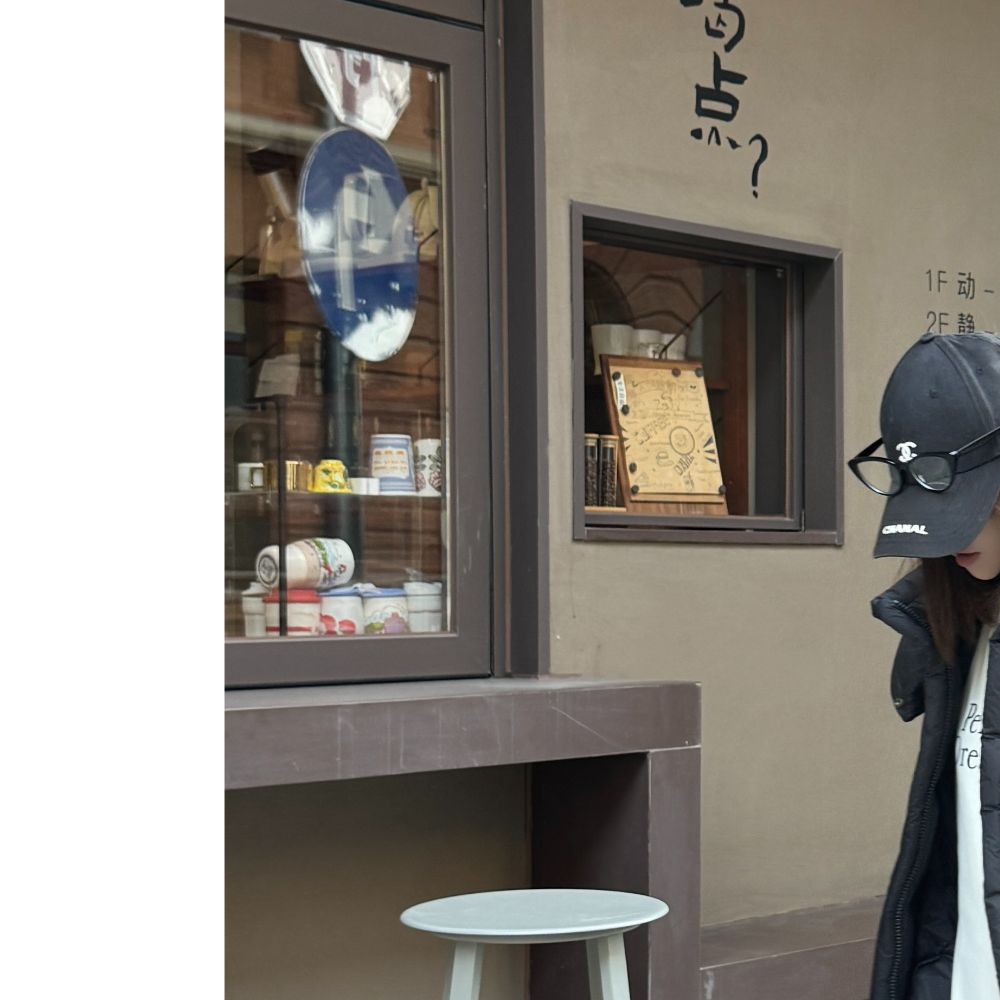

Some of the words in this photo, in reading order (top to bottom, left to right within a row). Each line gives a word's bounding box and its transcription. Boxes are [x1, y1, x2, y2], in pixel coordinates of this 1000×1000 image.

[925, 269, 948, 293] 1F
[957, 271, 976, 300] 动
[926, 310, 949, 333] 2F
